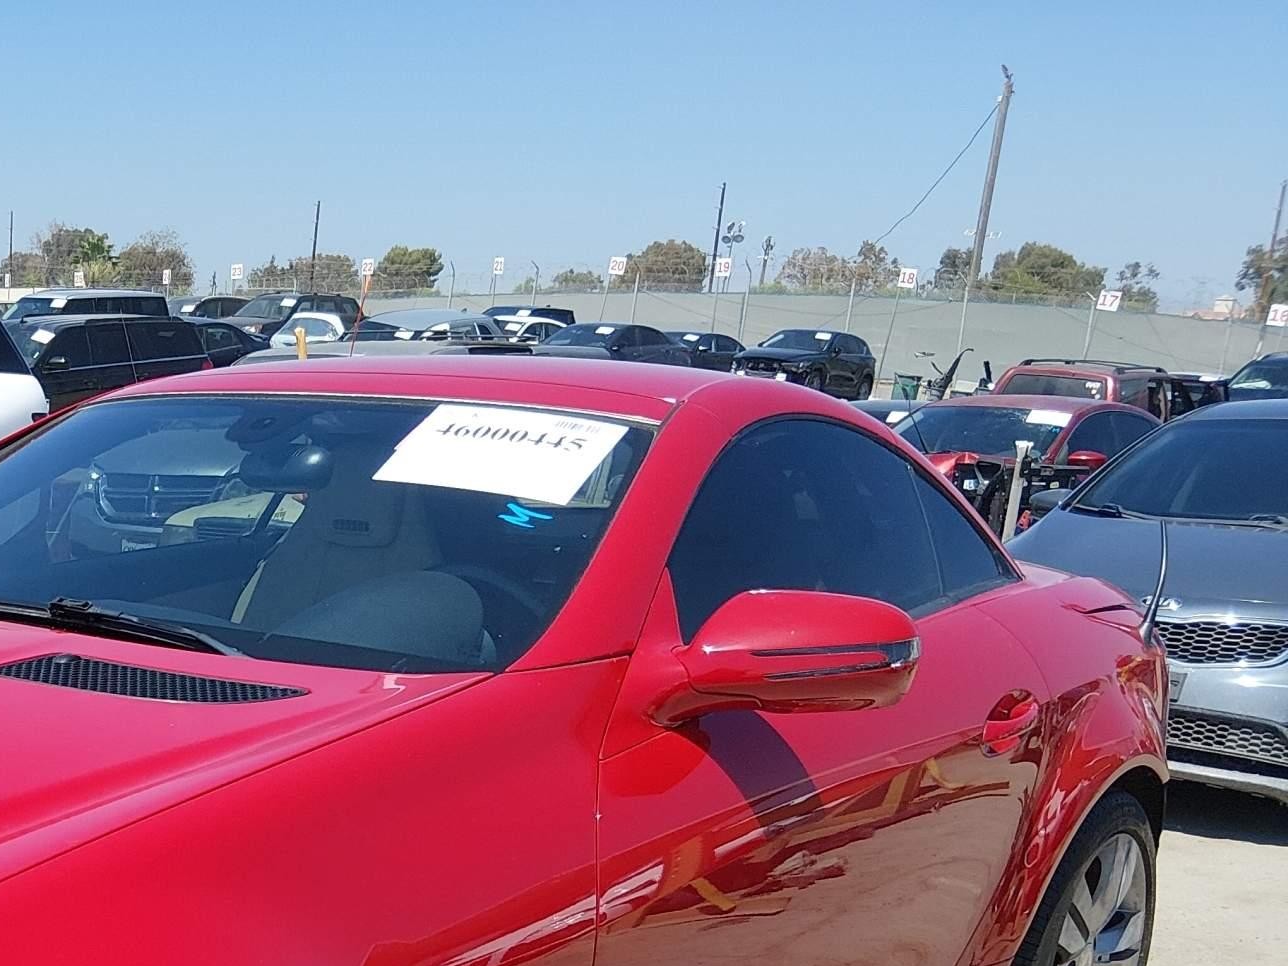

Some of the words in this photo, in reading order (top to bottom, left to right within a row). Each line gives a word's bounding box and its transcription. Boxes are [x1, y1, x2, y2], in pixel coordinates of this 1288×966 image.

[363, 262, 373, 271] 22
[611, 260, 624, 271] 20
[718, 261, 730, 272] 19
[232, 267, 242, 276] 23
[900, 271, 915, 284] 18
[1099, 295, 1120, 307] 17
[436, 423, 588, 451] 46000445
